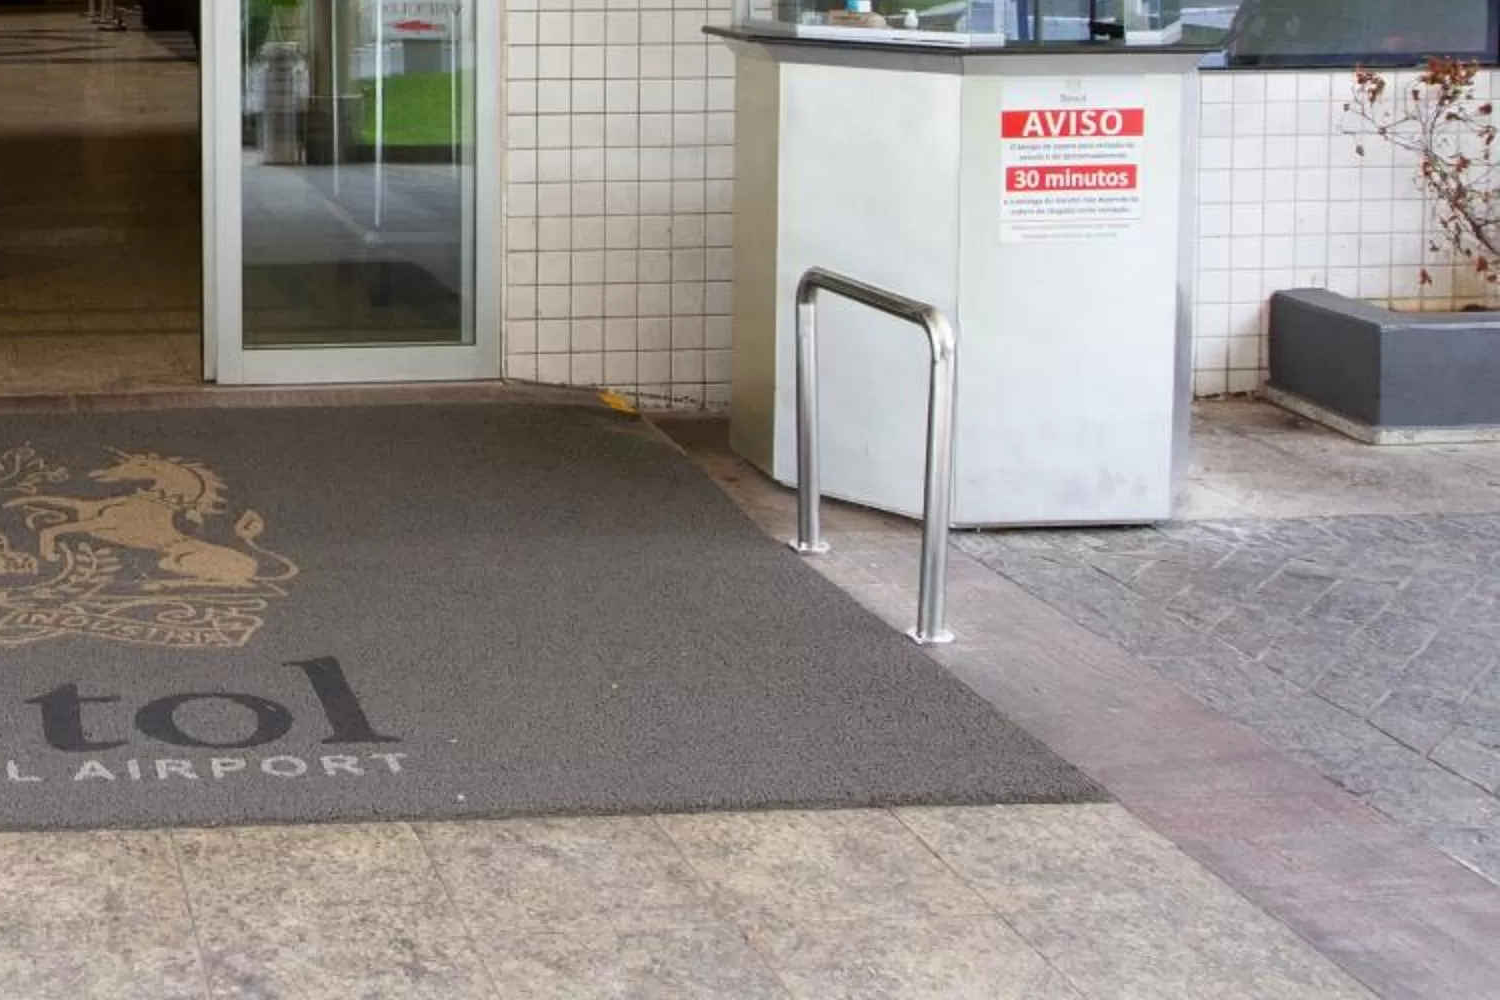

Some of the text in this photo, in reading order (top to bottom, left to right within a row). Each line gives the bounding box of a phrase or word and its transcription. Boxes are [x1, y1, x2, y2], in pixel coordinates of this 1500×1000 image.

[1022, 109, 1123, 136] AVISO
[1014, 168, 1128, 188] 30 minutos
[73, 753, 408, 783] AIRPORT
